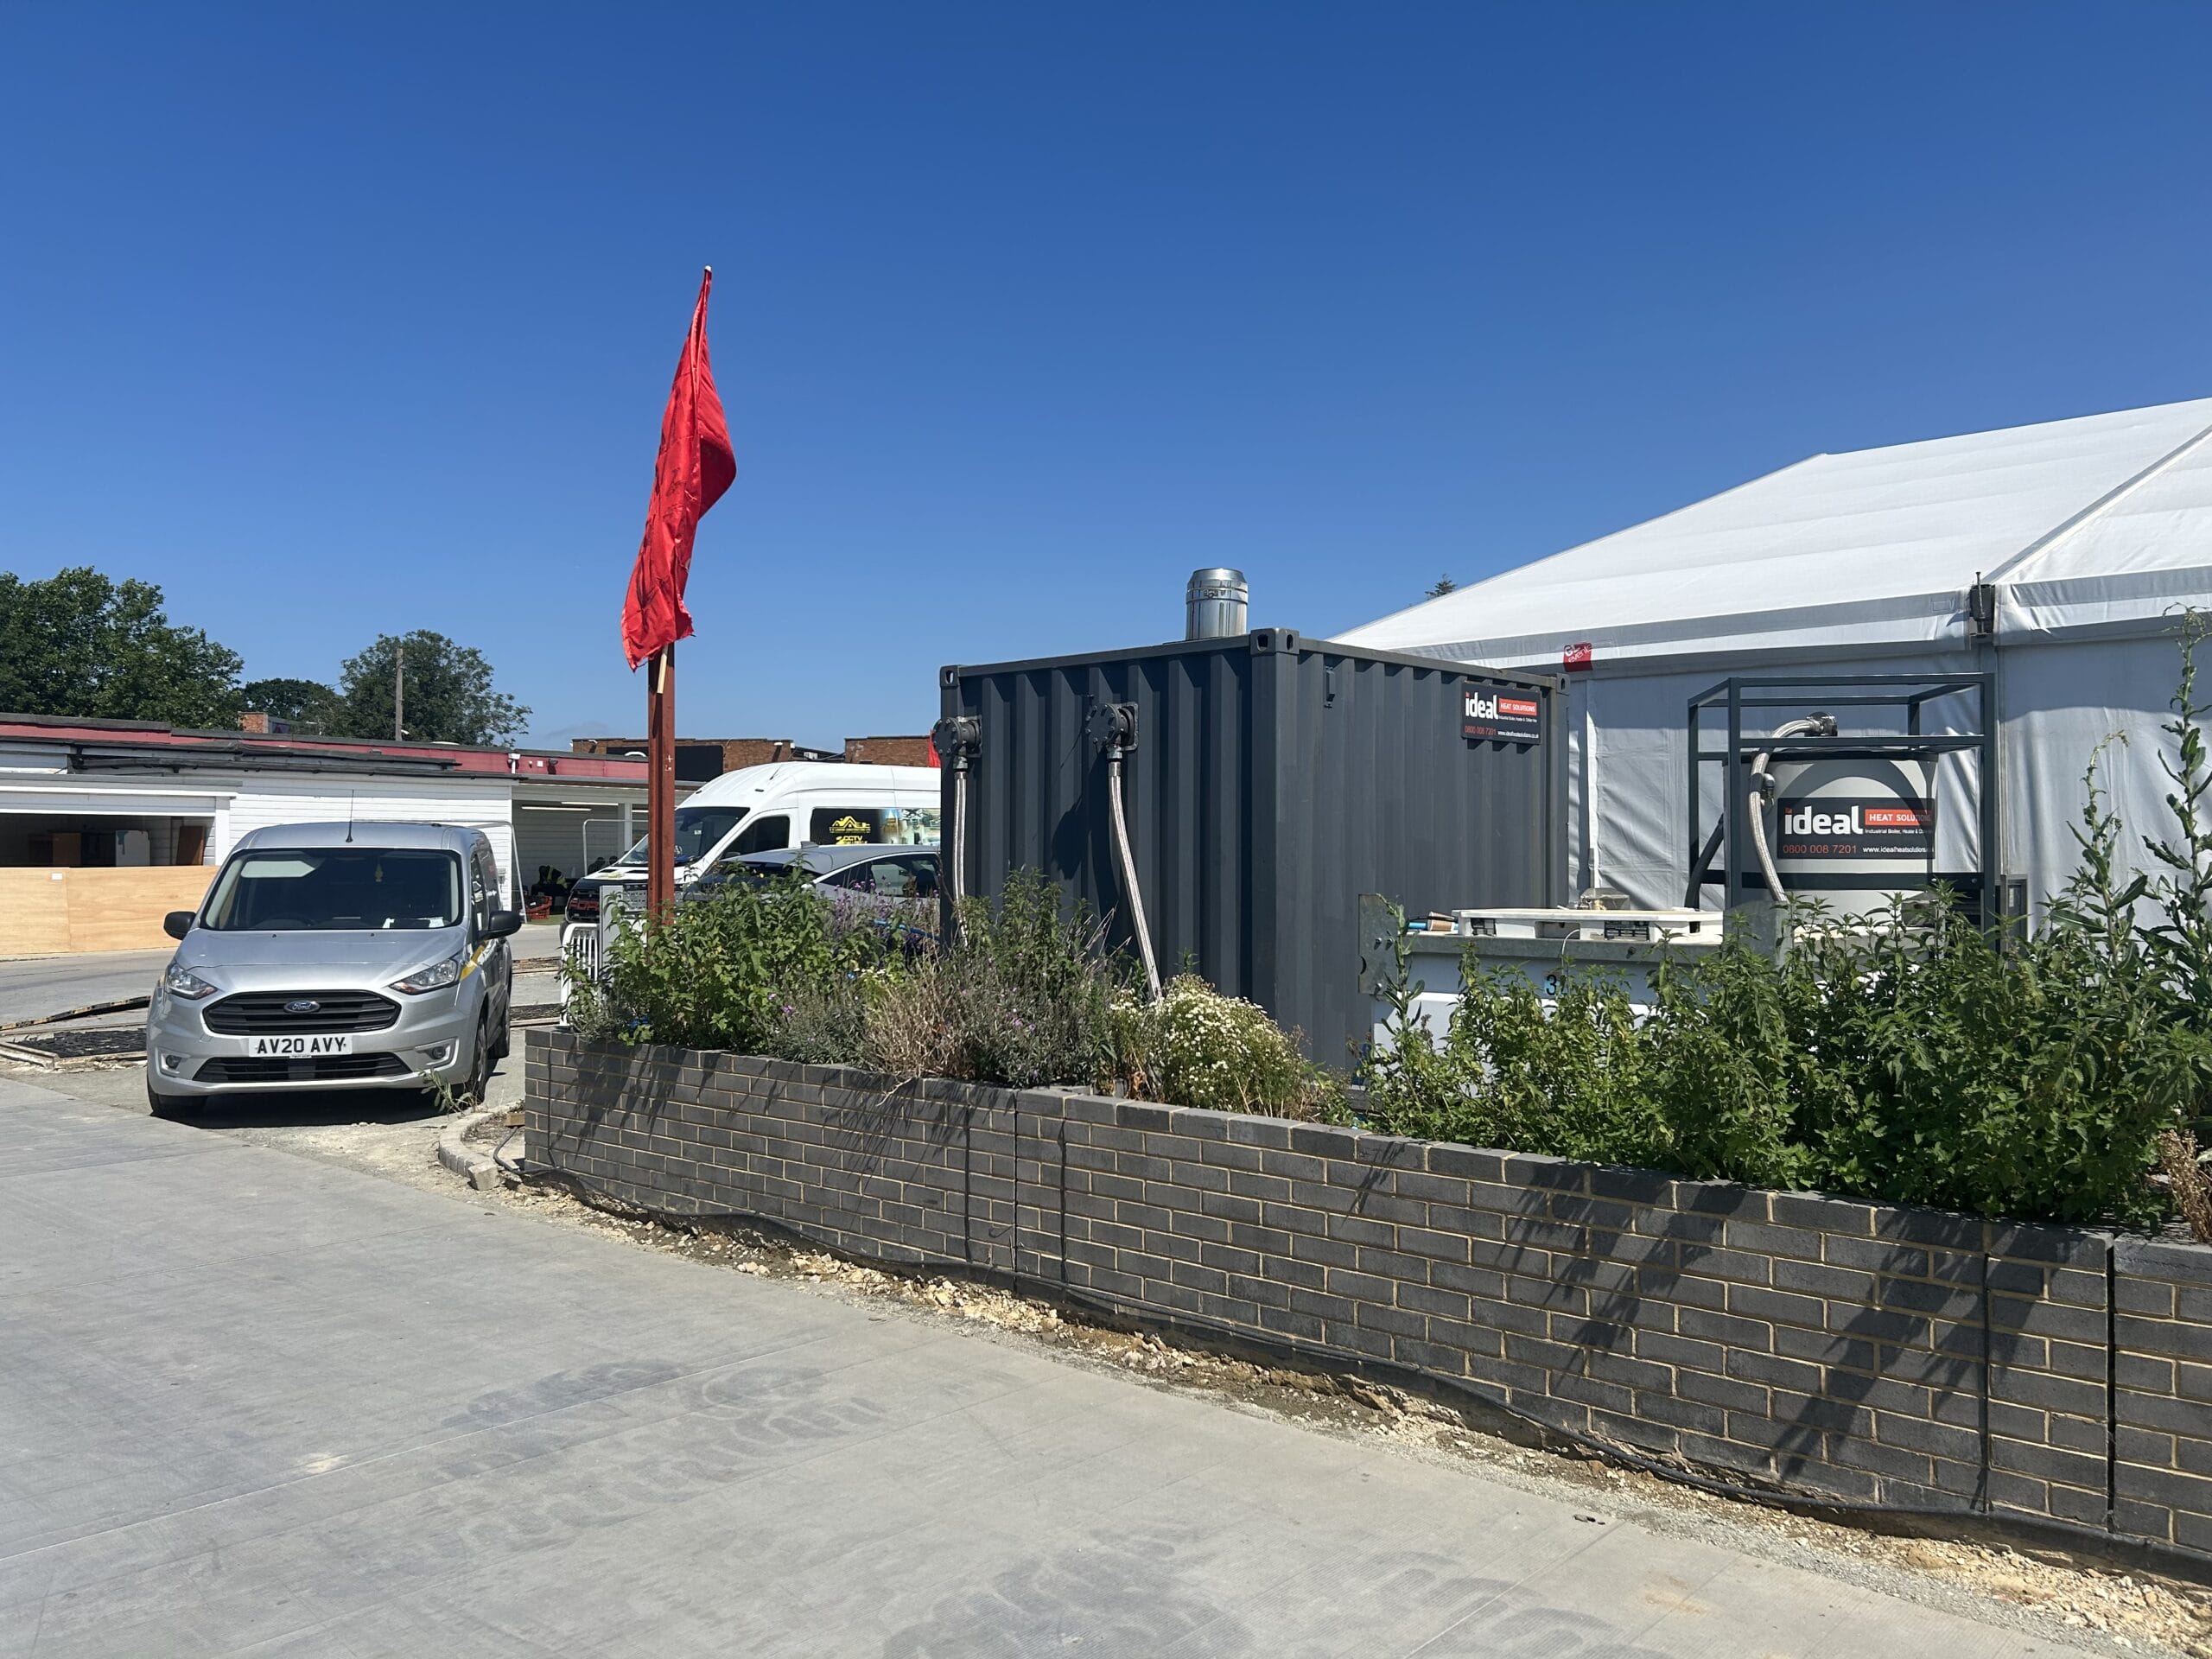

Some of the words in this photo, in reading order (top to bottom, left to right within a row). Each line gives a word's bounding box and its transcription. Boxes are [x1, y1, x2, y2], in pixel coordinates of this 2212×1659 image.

[1465, 692, 1498, 720] ideal
[1512, 703, 1535, 712] SOLUTIONS
[1784, 805, 1863, 835] ideal
[1783, 844, 1807, 854] 0800
[1809, 844, 1829, 854] 008
[1833, 844, 1857, 854] 7201
[291, 1001, 312, 1010] Ford
[257, 1039, 305, 1054] AV20
[310, 1037, 346, 1053] AVY
